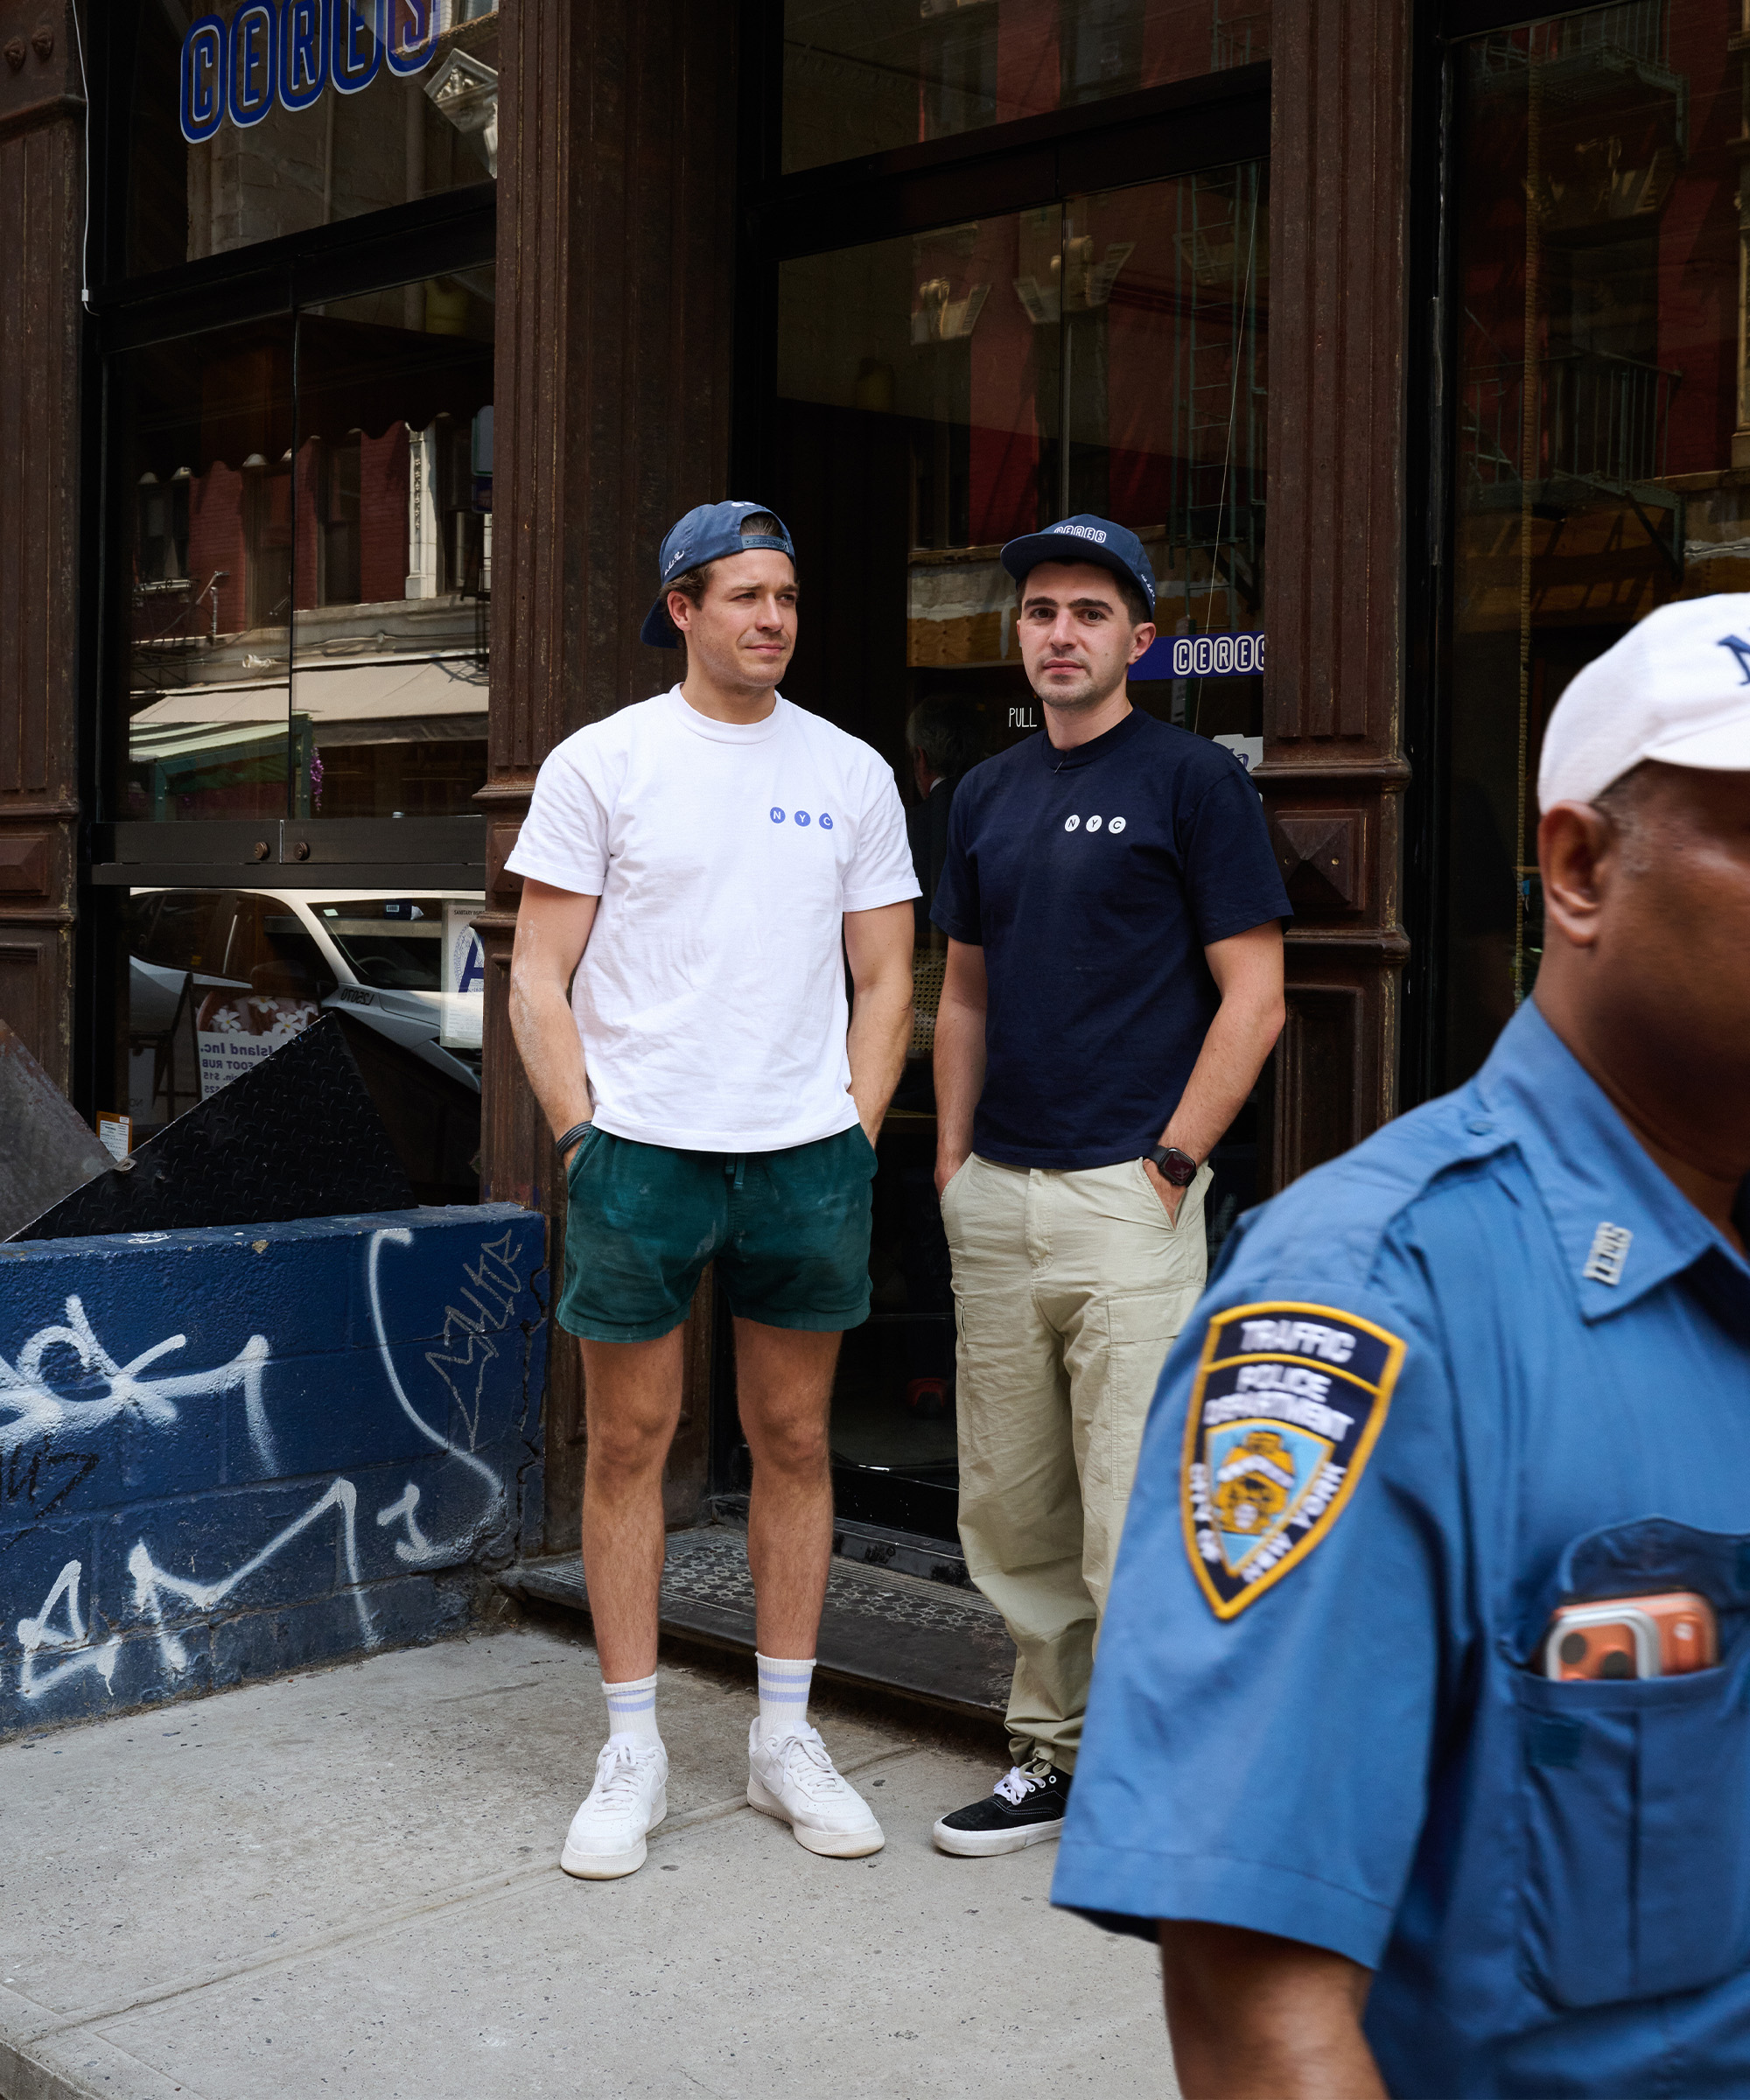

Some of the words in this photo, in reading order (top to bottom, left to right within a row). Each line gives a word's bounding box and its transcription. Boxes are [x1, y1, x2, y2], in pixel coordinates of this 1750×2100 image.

[1009, 707, 1037, 727] PULL
[458, 930, 484, 993] A
[1240, 1320, 1356, 1362] TRAFFIC
[1236, 1364, 1332, 1403] POLICE
